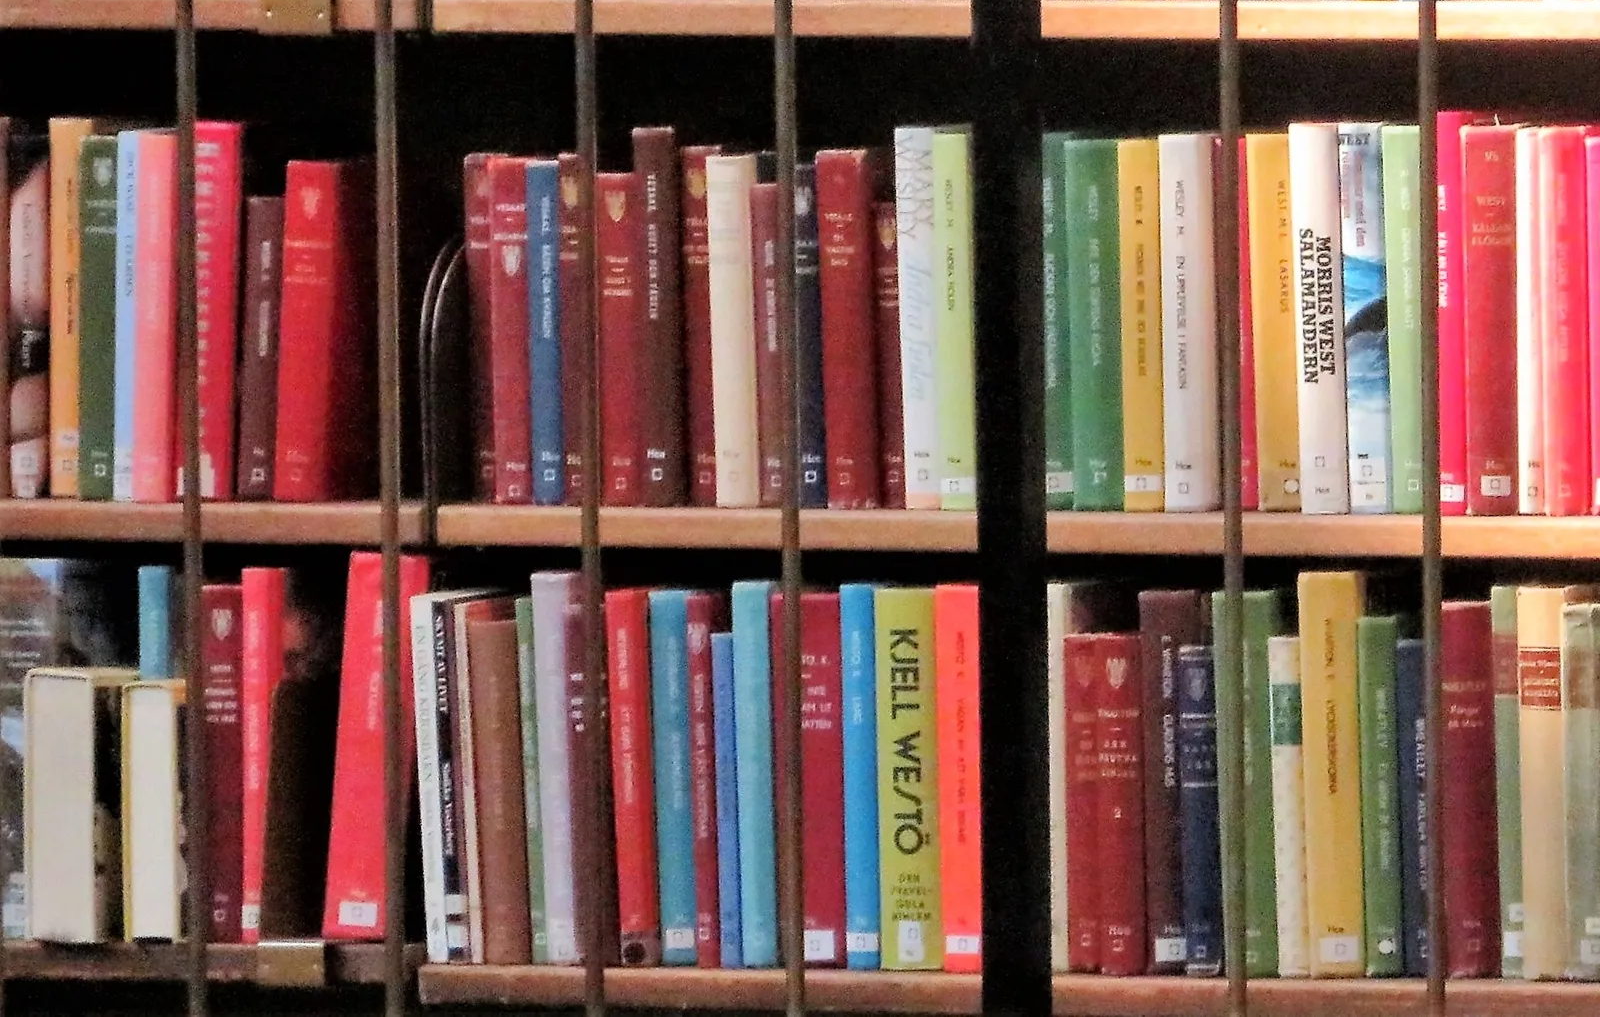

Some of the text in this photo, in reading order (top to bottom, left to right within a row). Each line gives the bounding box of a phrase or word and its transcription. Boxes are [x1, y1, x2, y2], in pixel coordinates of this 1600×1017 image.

[1278, 258, 1290, 314] LASARUS
[1299, 228, 1319, 385] SALAMANDERN
[1317, 235, 1335, 375] MORRIS WEST
[889, 628, 931, 856] KJELL WESTÖ
